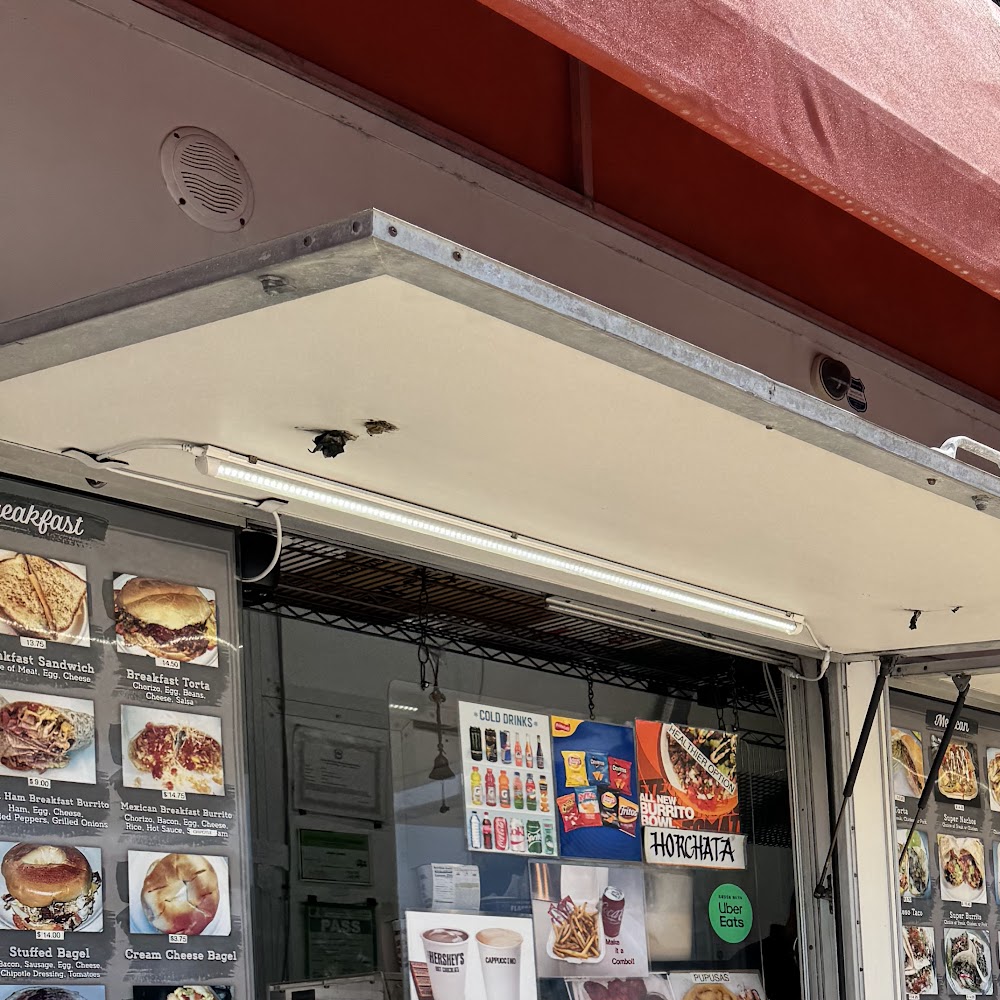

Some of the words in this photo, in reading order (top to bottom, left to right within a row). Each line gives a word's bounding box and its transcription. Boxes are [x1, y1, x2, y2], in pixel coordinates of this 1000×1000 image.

[0, 504, 84, 535] eakfast
[38, 656, 95, 674] Sandwich
[63, 672, 91, 683] Cheese
[126, 668, 179, 686] Breakfast
[183, 677, 210, 692] Torta
[479, 710, 501, 723] COLD
[503, 713, 533, 728] DRINKS
[668, 725, 708, 767] HEALTHIER
[707, 764, 735, 793] OPTION
[4, 792, 26, 802] Ham
[29, 794, 73, 806] Breakfast
[77, 798, 110, 809] Burrito
[640, 793, 656, 803] ALL
[656, 795, 676, 805] NEW
[120, 801, 158, 813] Mexican
[160, 805, 201, 816] Breakfast
[202, 809, 233, 819] Burrito
[640, 802, 695, 820] BURRITO
[52, 817, 79, 826] Grilled
[146, 824, 160, 832] Hot
[650, 832, 735, 863] HORCHATA
[718, 902, 743, 914] Uber
[321, 918, 361, 934] PASS
[720, 916, 745, 928] Eats
[170, 935, 186, 943] $3.75
[9, 946, 53, 958] Stuffed
[57, 947, 90, 960] Bagel
[125, 949, 162, 960] Cream
[165, 950, 204, 961] Cheese
[207, 951, 237, 962] Bagel
[427, 950, 465, 966] HERSHEY'S
[693, 973, 730, 982] PUPUSAS
